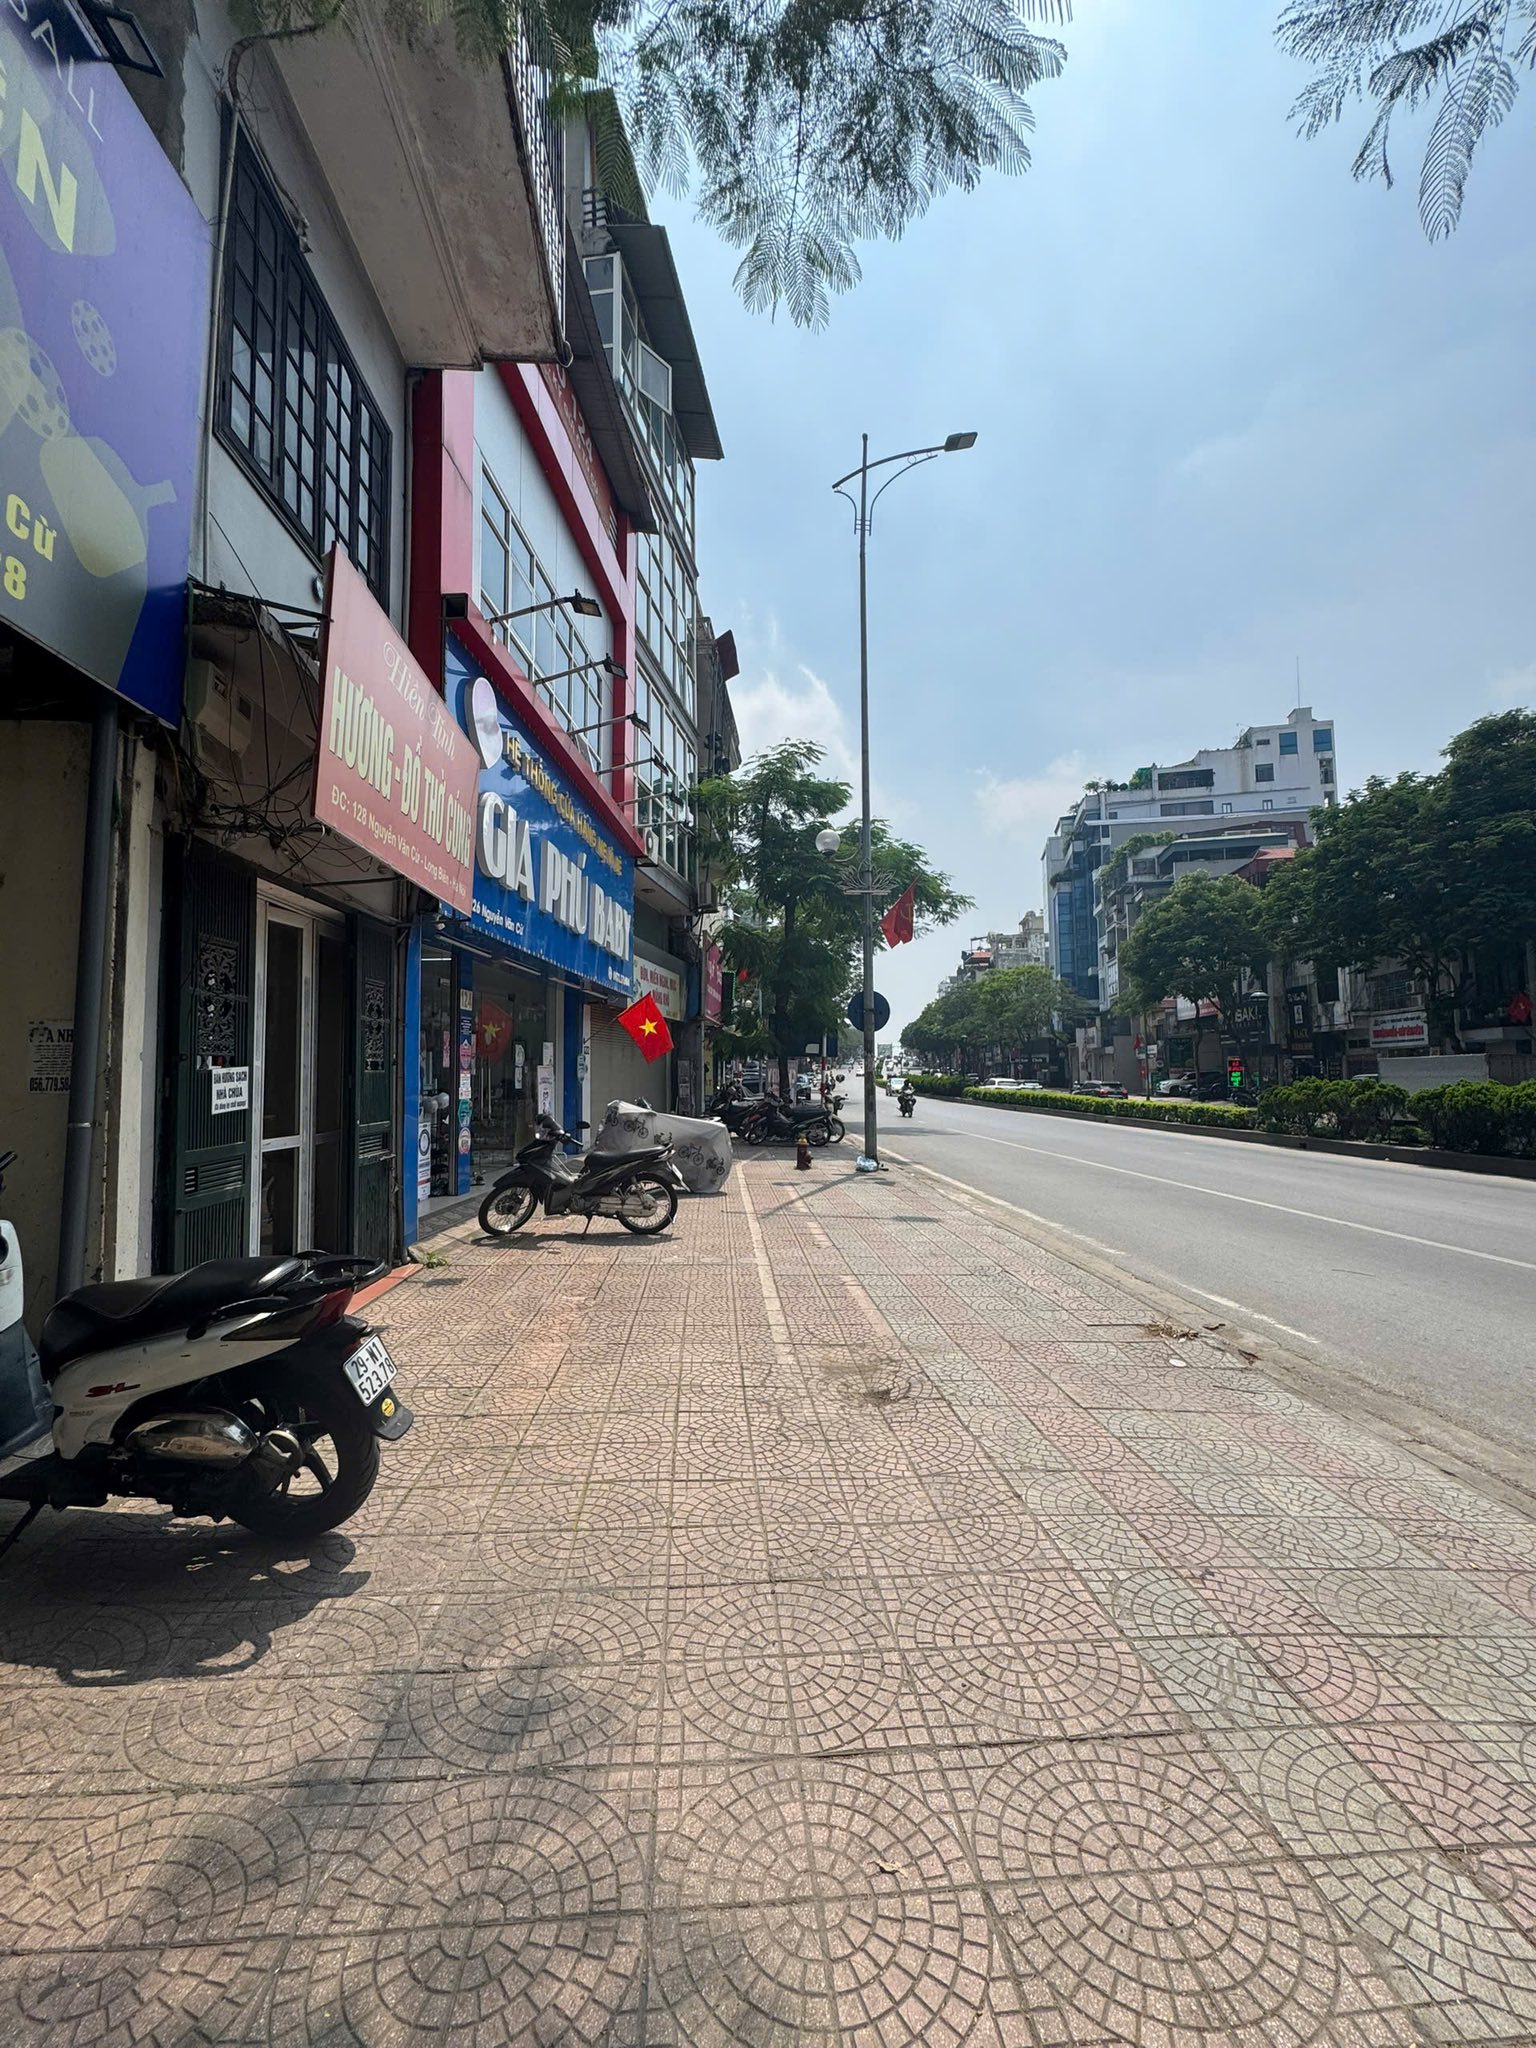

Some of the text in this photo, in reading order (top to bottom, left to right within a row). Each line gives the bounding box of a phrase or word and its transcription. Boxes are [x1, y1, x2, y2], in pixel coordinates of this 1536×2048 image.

[0, 75, 77, 254] N
[6, 493, 57, 561] Cừ
[329, 665, 394, 800] HƯƠNG
[423, 766, 446, 845] THỜ
[445, 789, 472, 869] CÚNG
[506, 736, 522, 771] HỆ
[331, 784, 350, 814] ĐC:
[352, 801, 367, 826] 128
[368, 815, 396, 848] Nguyễn
[398, 834, 412, 858] Văn
[424, 856, 438, 881] Long
[480, 791, 631, 961] GIA PHÚ BABY
[482, 902, 503, 926] Nguyễn
[504, 915, 515, 931] Văn
[351, 1341, 383, 1379] 29-N1
[358, 1357, 395, 1400] 523.78
